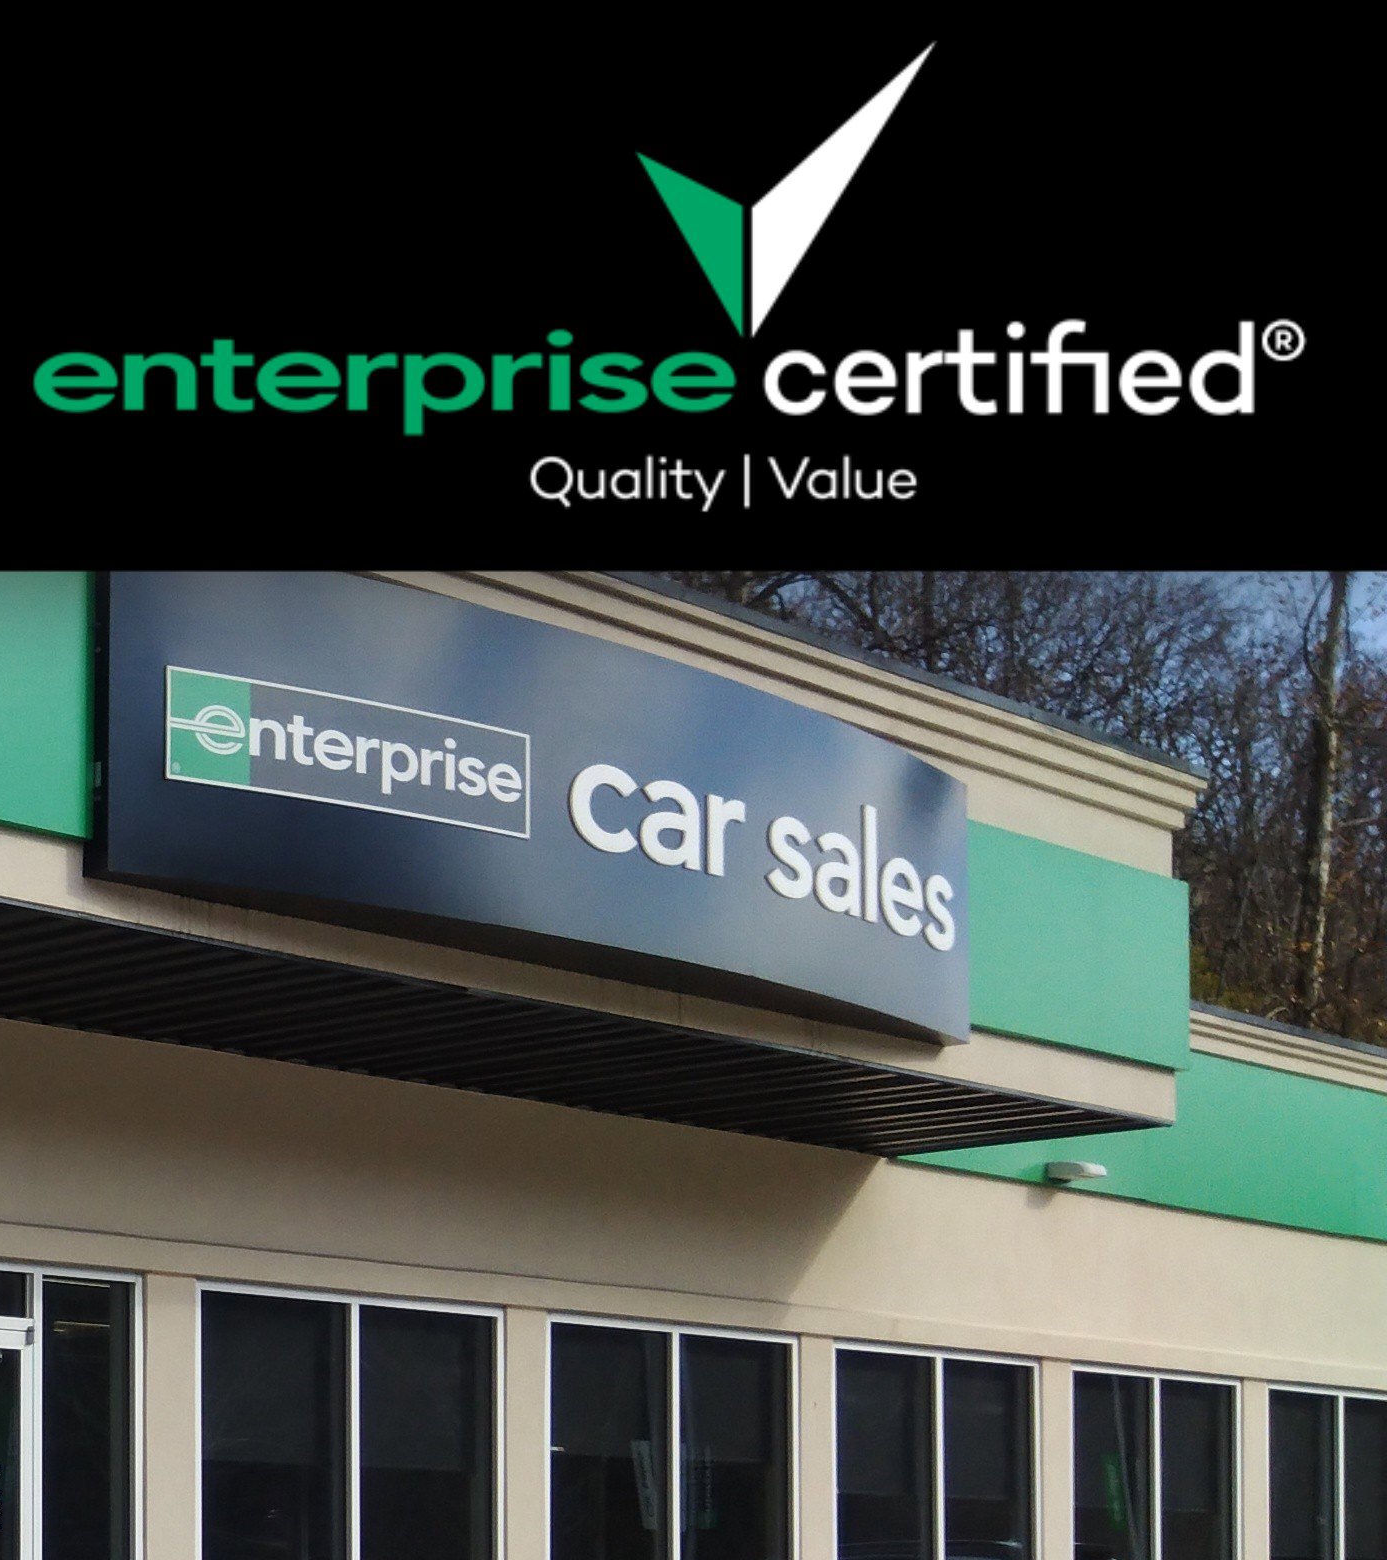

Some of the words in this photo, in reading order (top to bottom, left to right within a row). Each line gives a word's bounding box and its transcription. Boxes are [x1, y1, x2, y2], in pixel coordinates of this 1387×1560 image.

[193, 704, 522, 803] enterprise
[569, 764, 746, 877] car
[765, 804, 956, 952] sales
